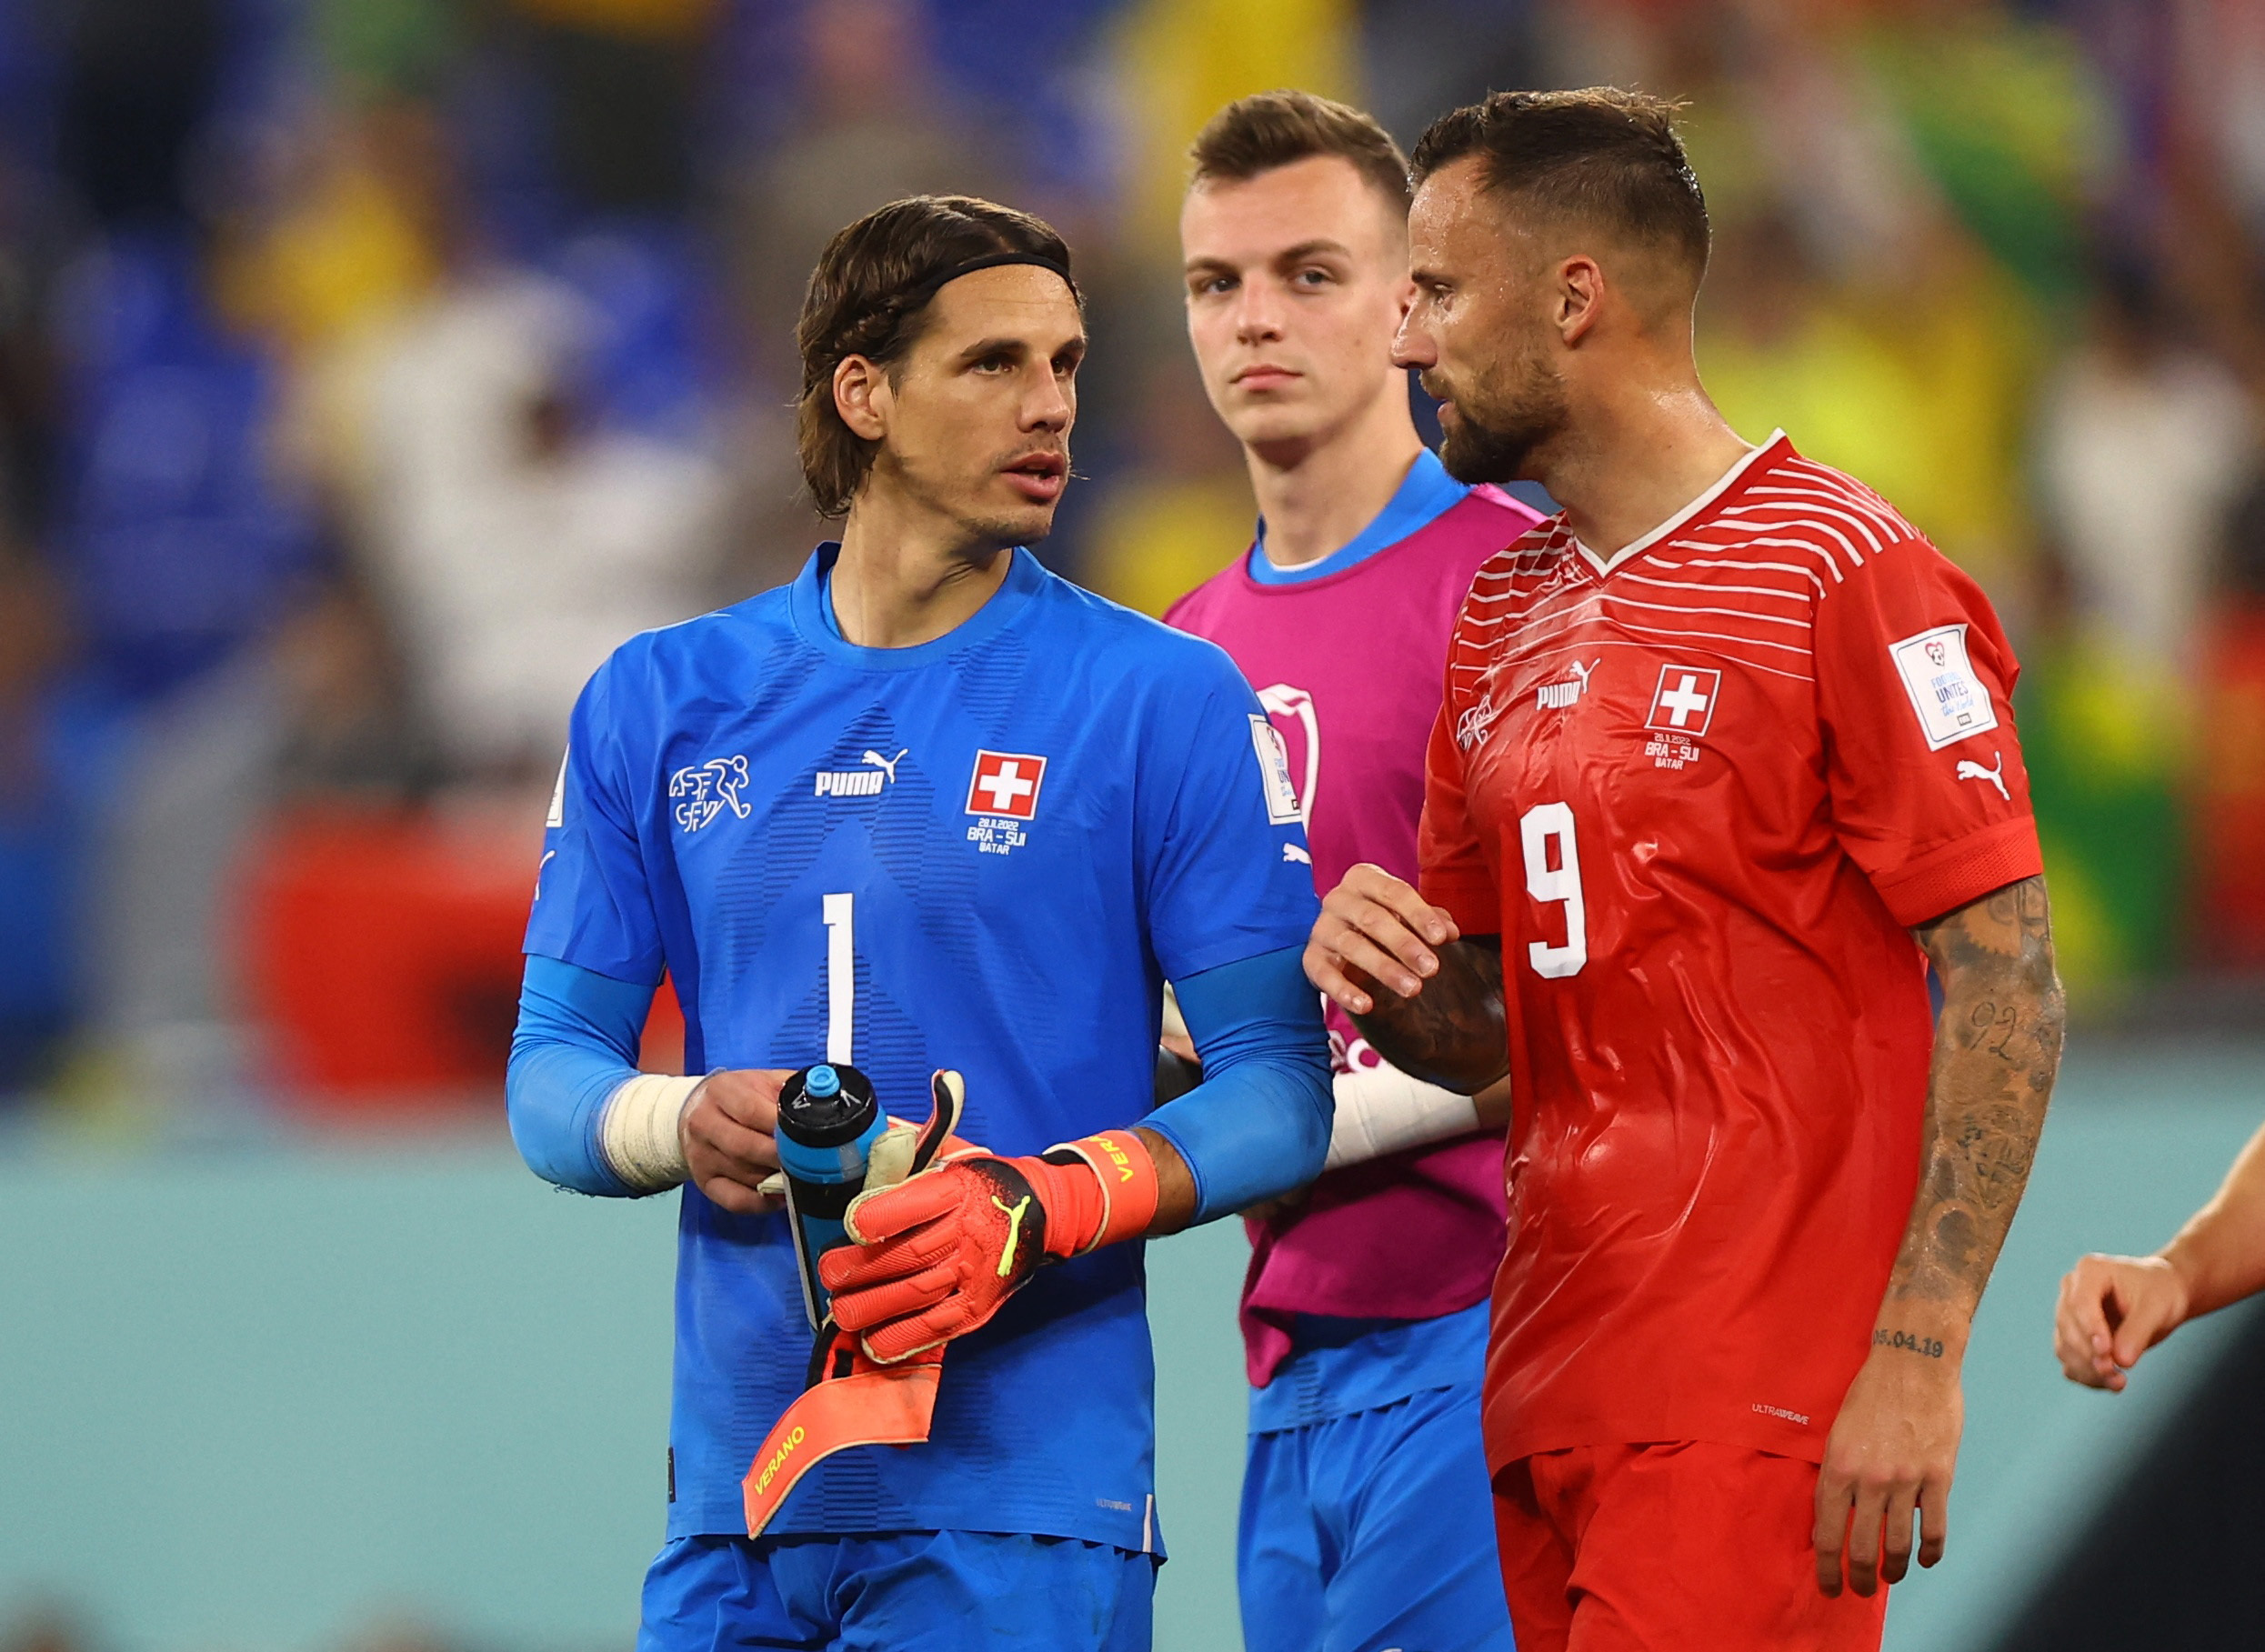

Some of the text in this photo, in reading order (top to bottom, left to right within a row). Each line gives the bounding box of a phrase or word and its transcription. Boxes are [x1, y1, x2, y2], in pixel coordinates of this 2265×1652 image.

[1537, 680, 1581, 711] PUMA
[1935, 680, 1969, 704] UNITES
[1645, 741, 1669, 757] BRA
[1679, 745, 1699, 762] SUI
[815, 771, 885, 796] PUMA
[967, 826, 994, 842] BRA
[1005, 830, 1027, 846] SUI
[1519, 801, 1589, 980] 9
[822, 893, 853, 1066] 1
[754, 1426, 805, 1497] VERANO
